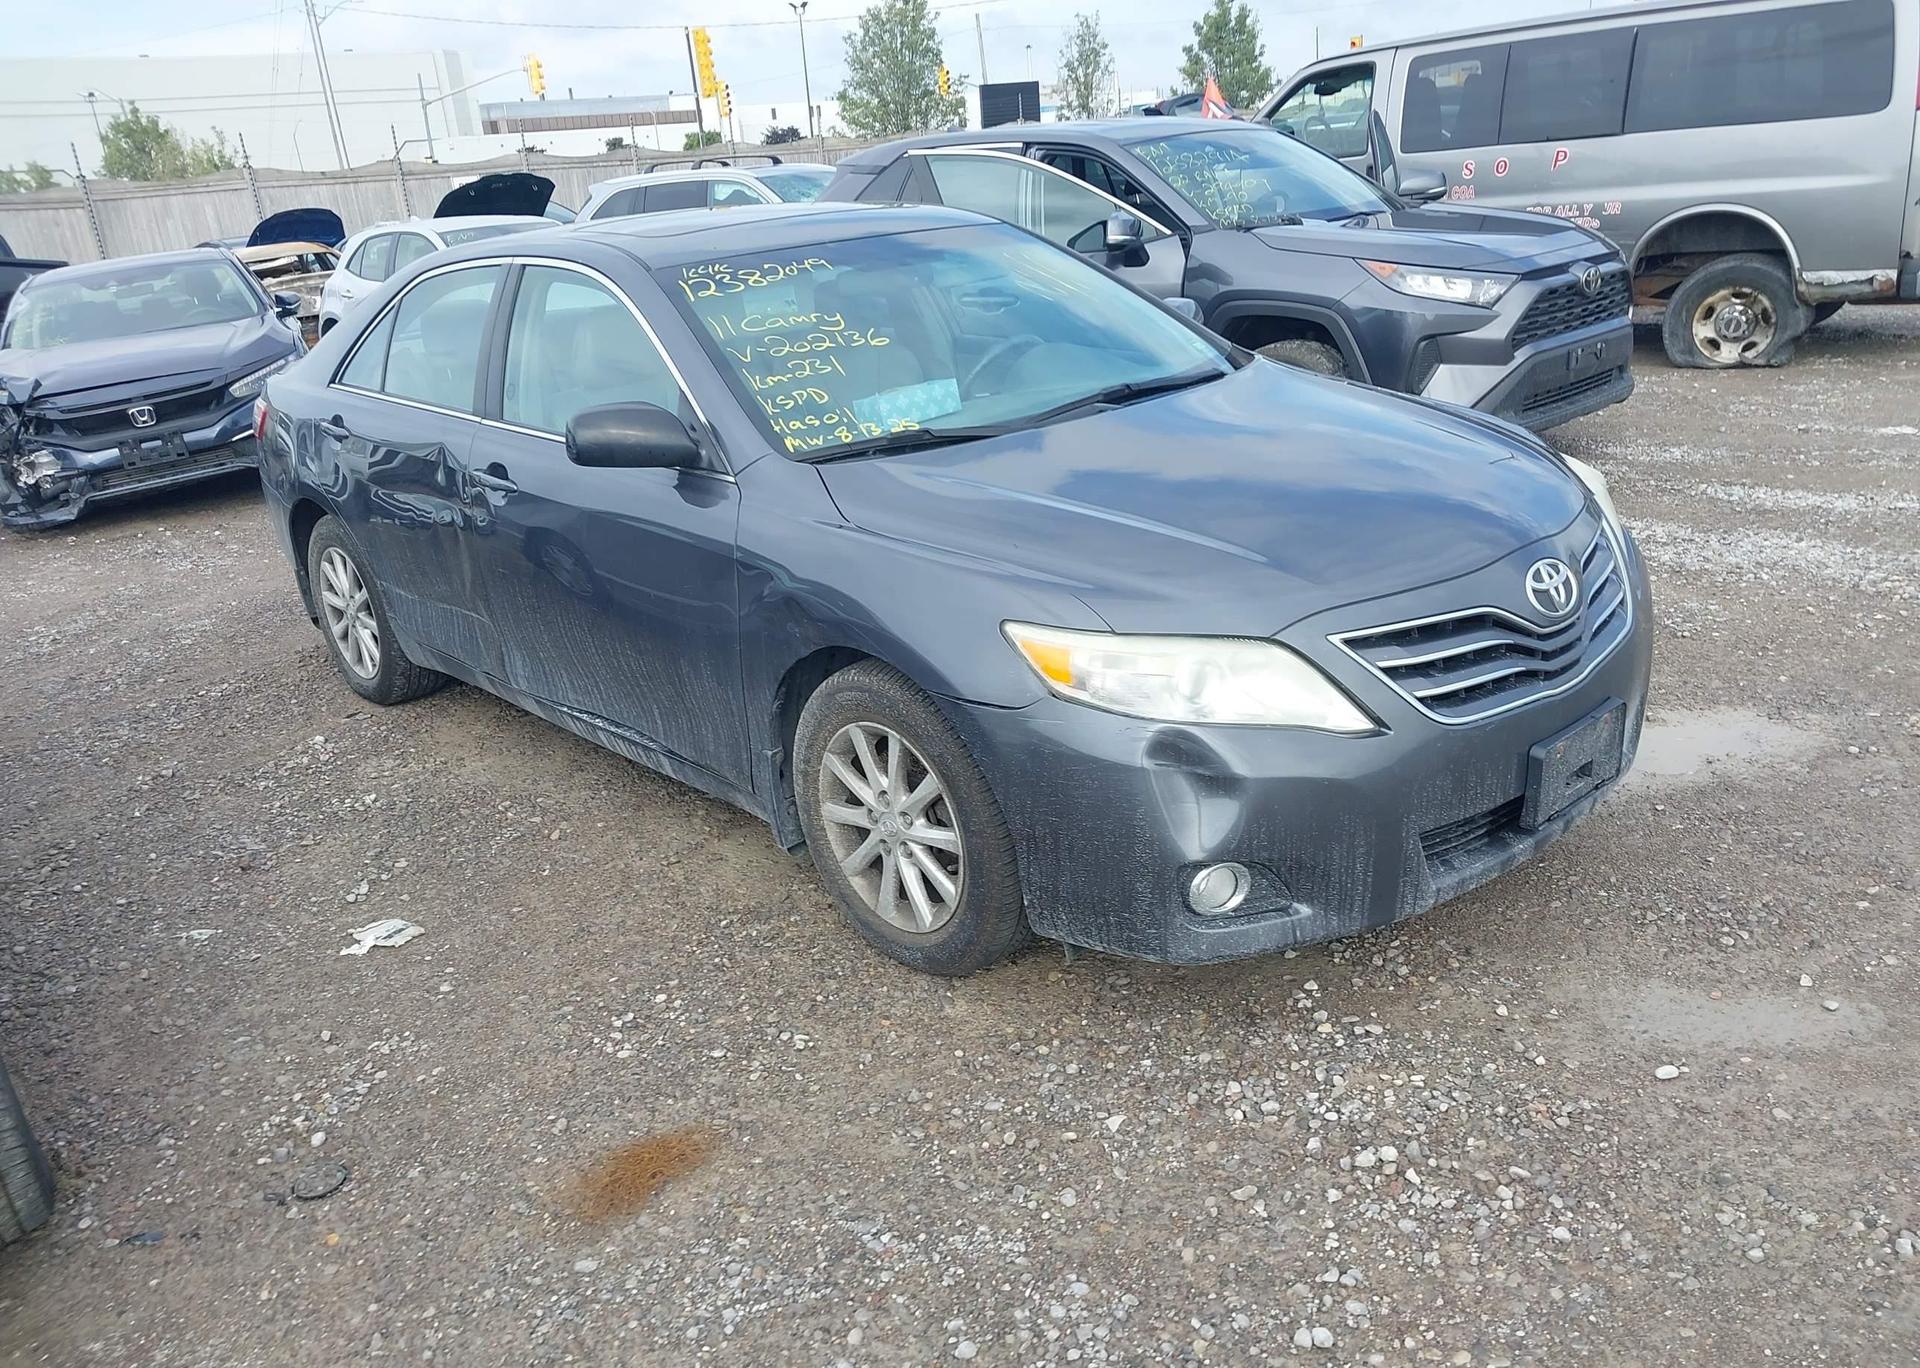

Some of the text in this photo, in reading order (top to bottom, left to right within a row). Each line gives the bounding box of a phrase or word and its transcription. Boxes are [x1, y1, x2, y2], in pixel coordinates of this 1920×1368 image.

[1462, 147, 1570, 179] S O P
[678, 258, 834, 302] 12382049
[740, 312, 846, 331] Camry
